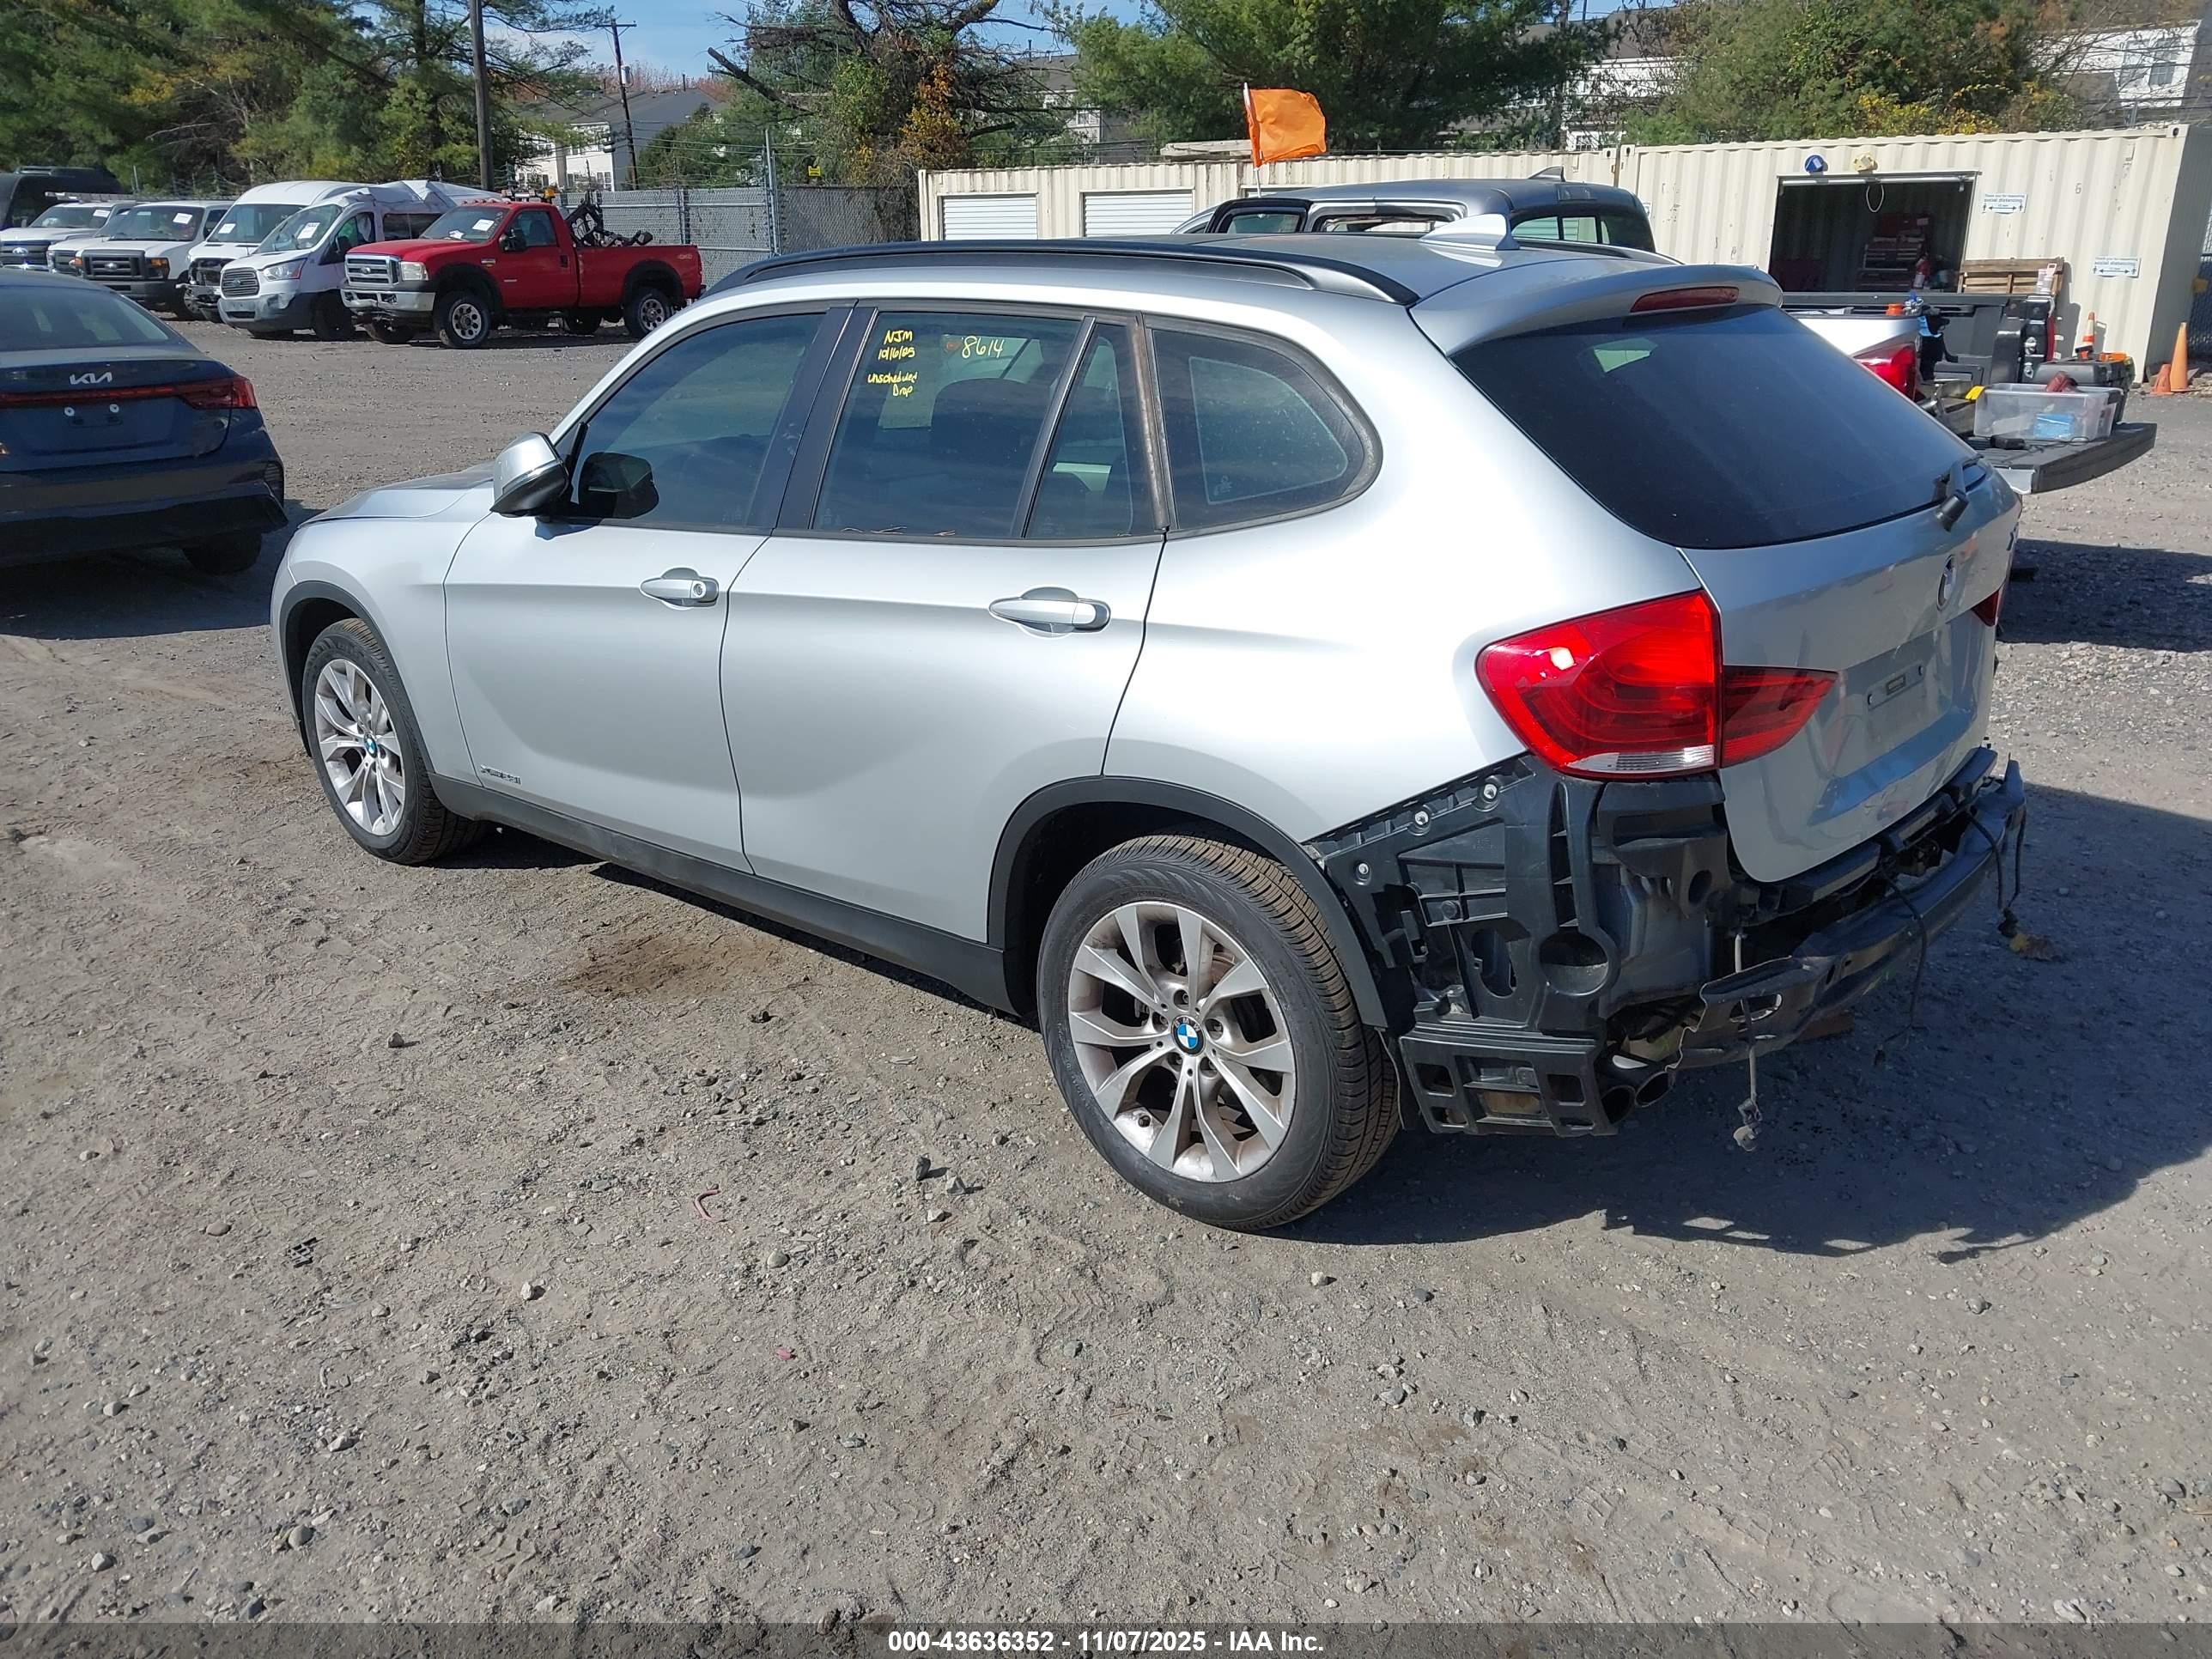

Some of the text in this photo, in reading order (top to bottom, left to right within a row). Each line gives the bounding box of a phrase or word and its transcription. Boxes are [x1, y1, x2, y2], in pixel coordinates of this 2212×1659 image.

[883, 330, 913, 345] NJM
[962, 336, 1005, 359] 8614
[1174, 1017, 1200, 1032] BMW
